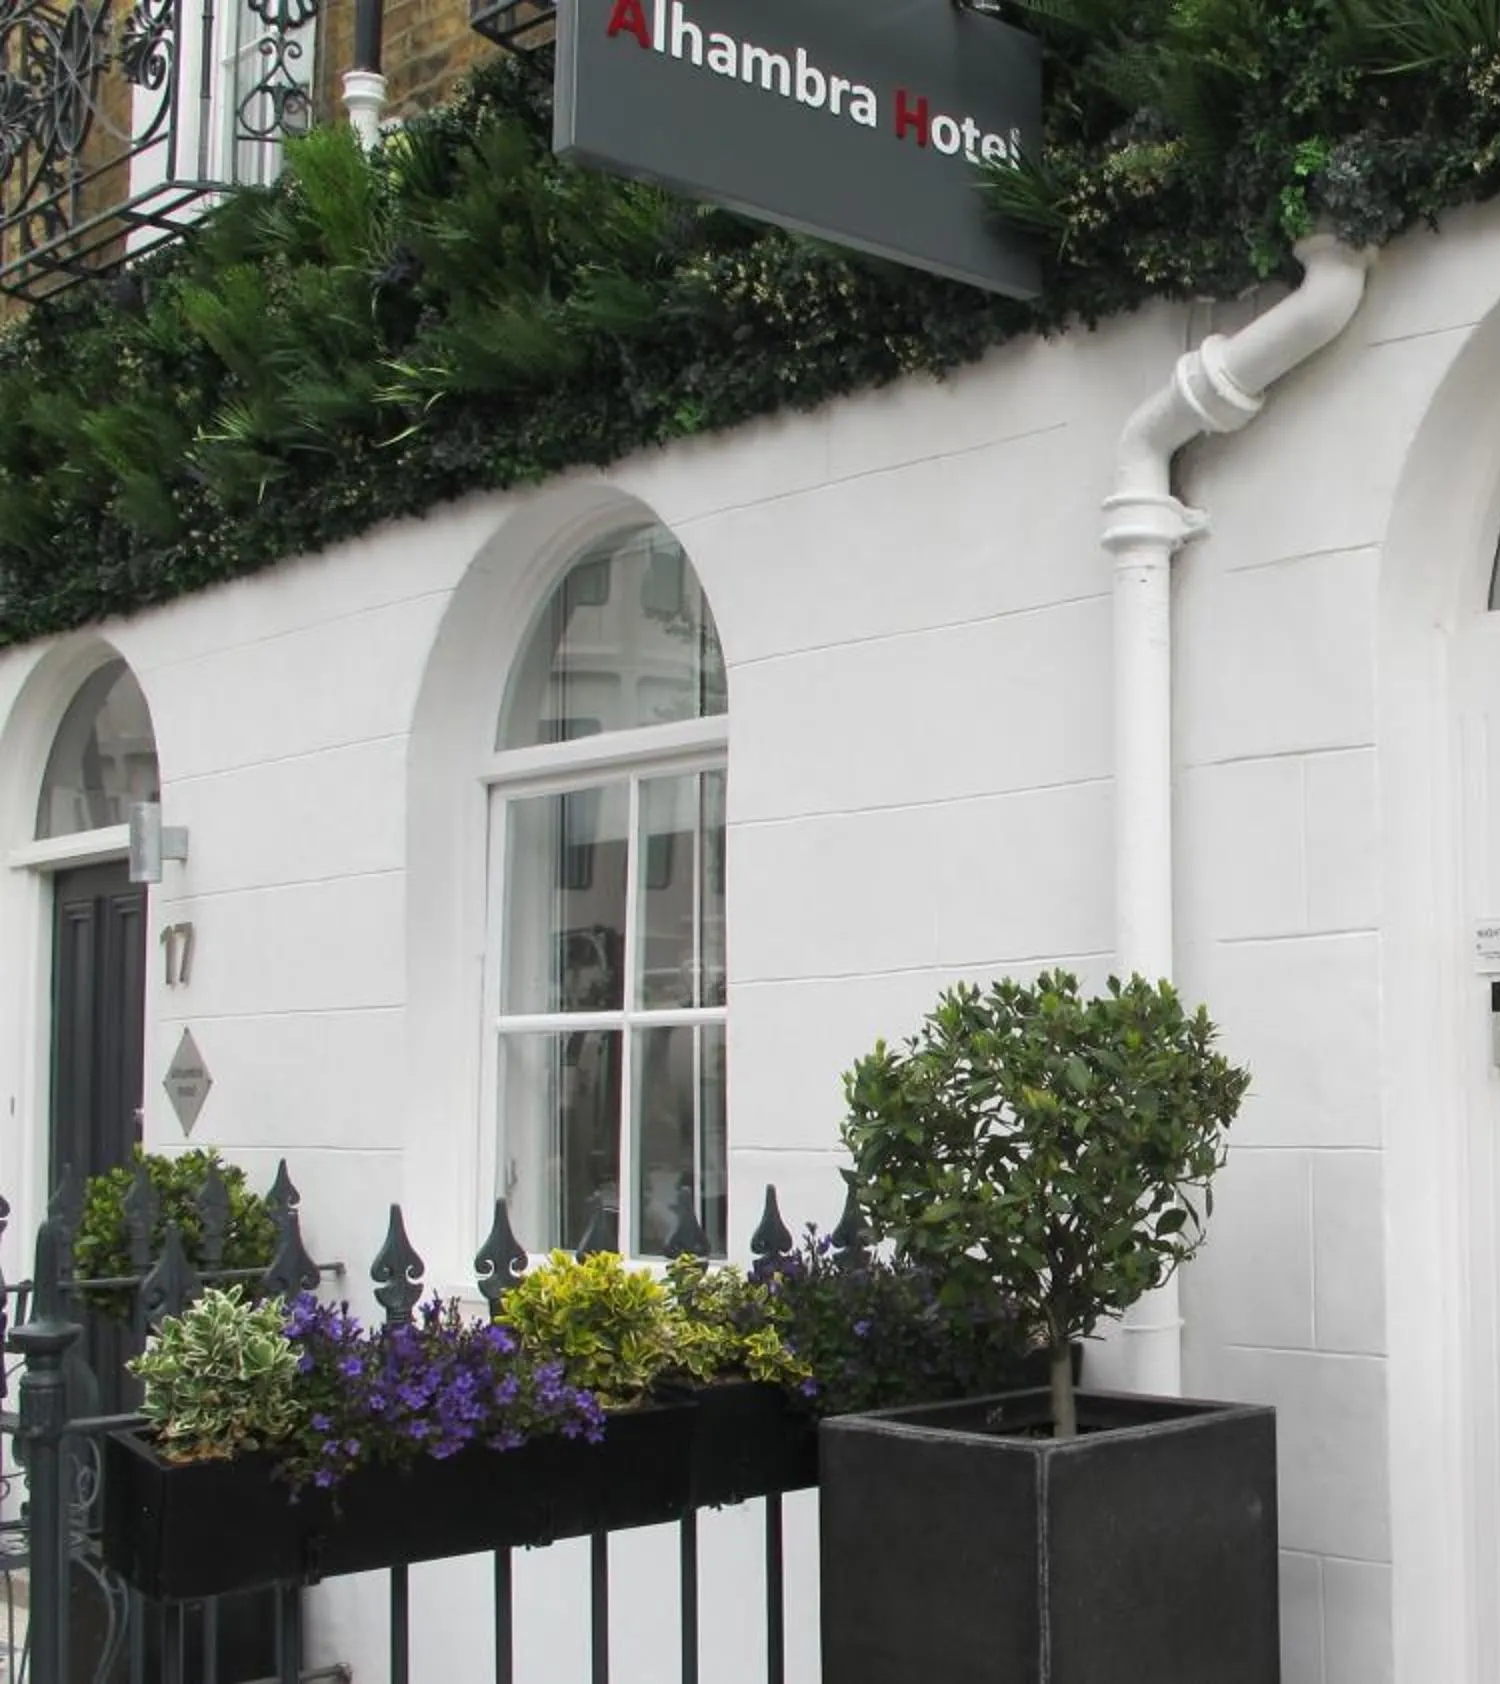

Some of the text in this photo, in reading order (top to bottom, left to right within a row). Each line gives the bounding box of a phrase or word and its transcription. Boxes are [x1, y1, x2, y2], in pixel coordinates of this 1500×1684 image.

[606, 0, 1021, 171] Alhambra Hotel
[160, 921, 193, 985] 17
